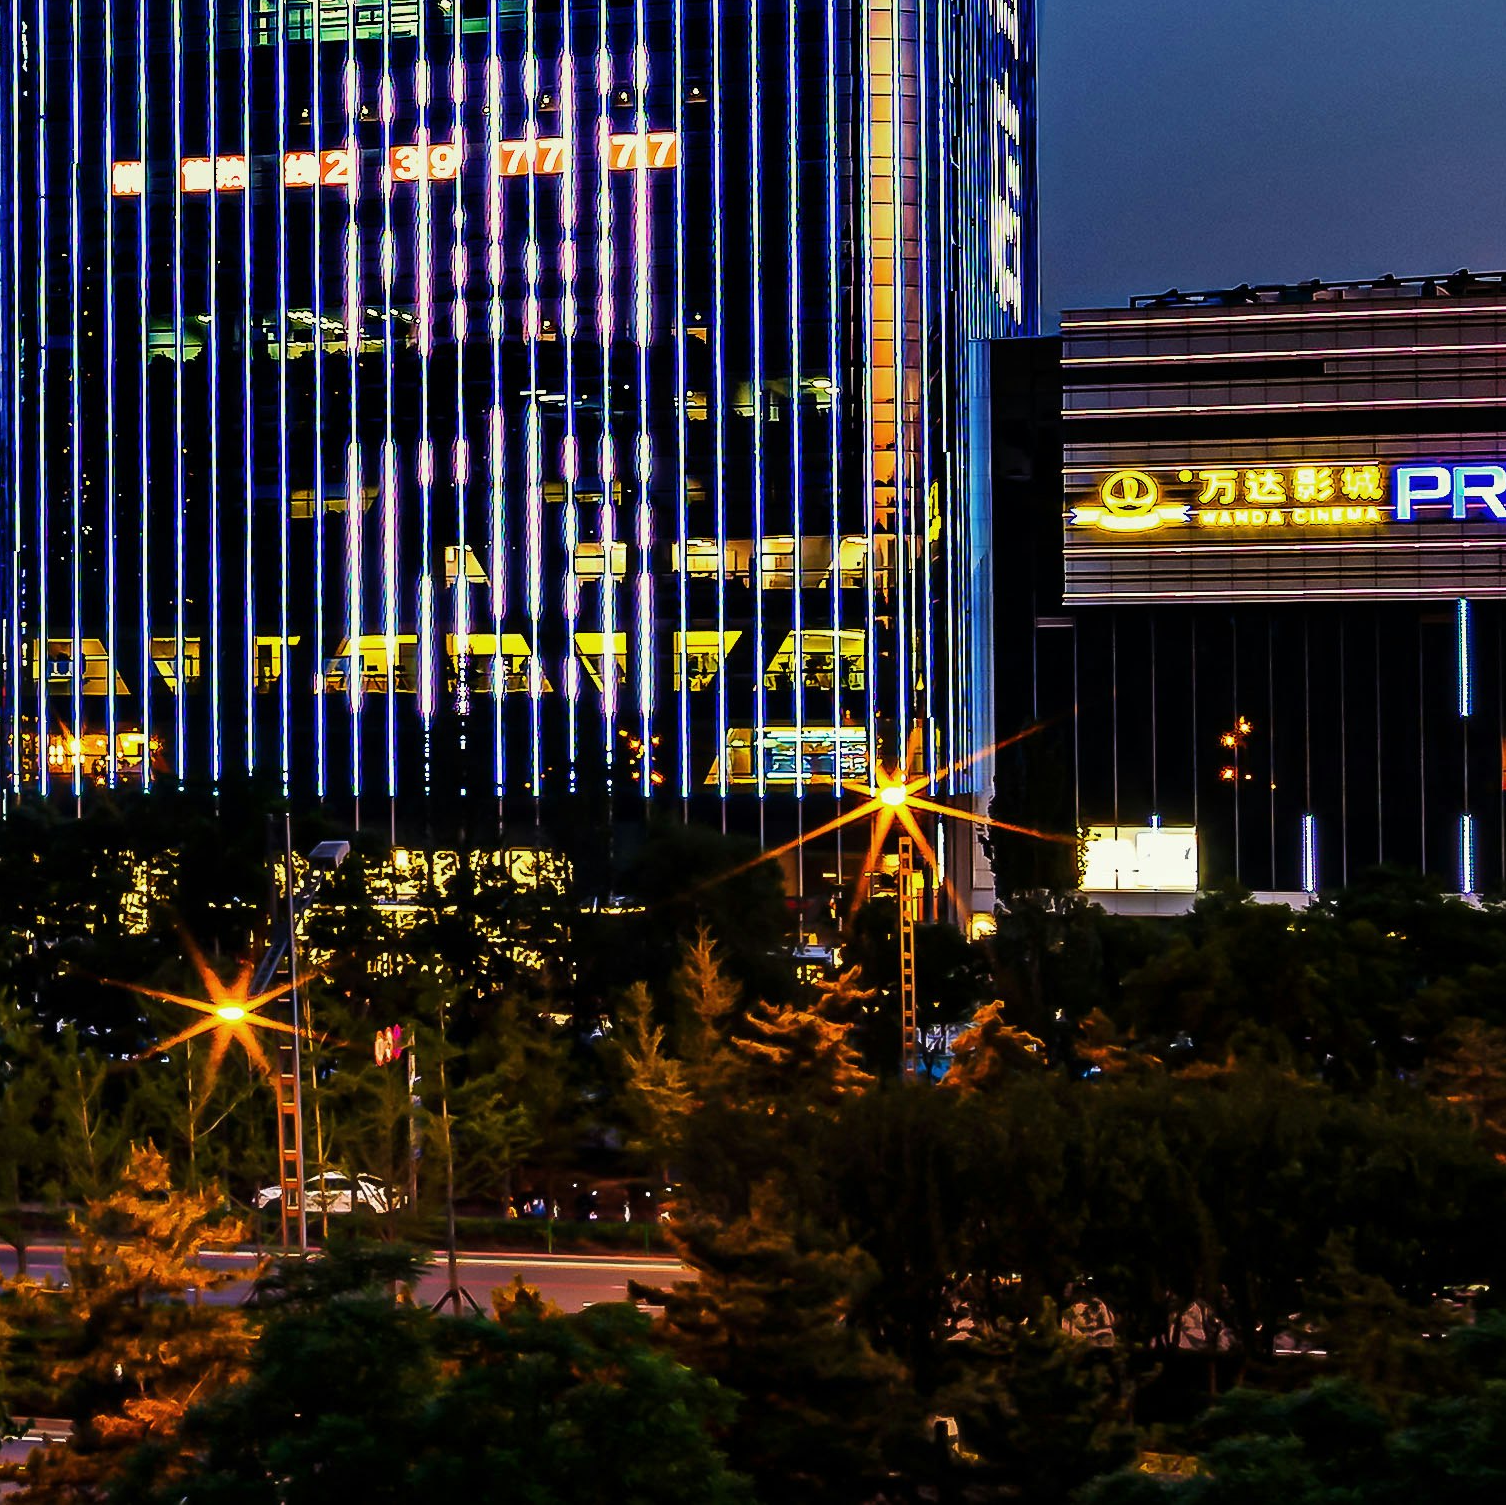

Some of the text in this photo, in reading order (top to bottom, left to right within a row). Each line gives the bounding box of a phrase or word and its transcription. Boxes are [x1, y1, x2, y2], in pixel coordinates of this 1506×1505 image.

[1198, 466, 1383, 504] 万达影城
[1199, 507, 1381, 526] WANDA CINEMA
